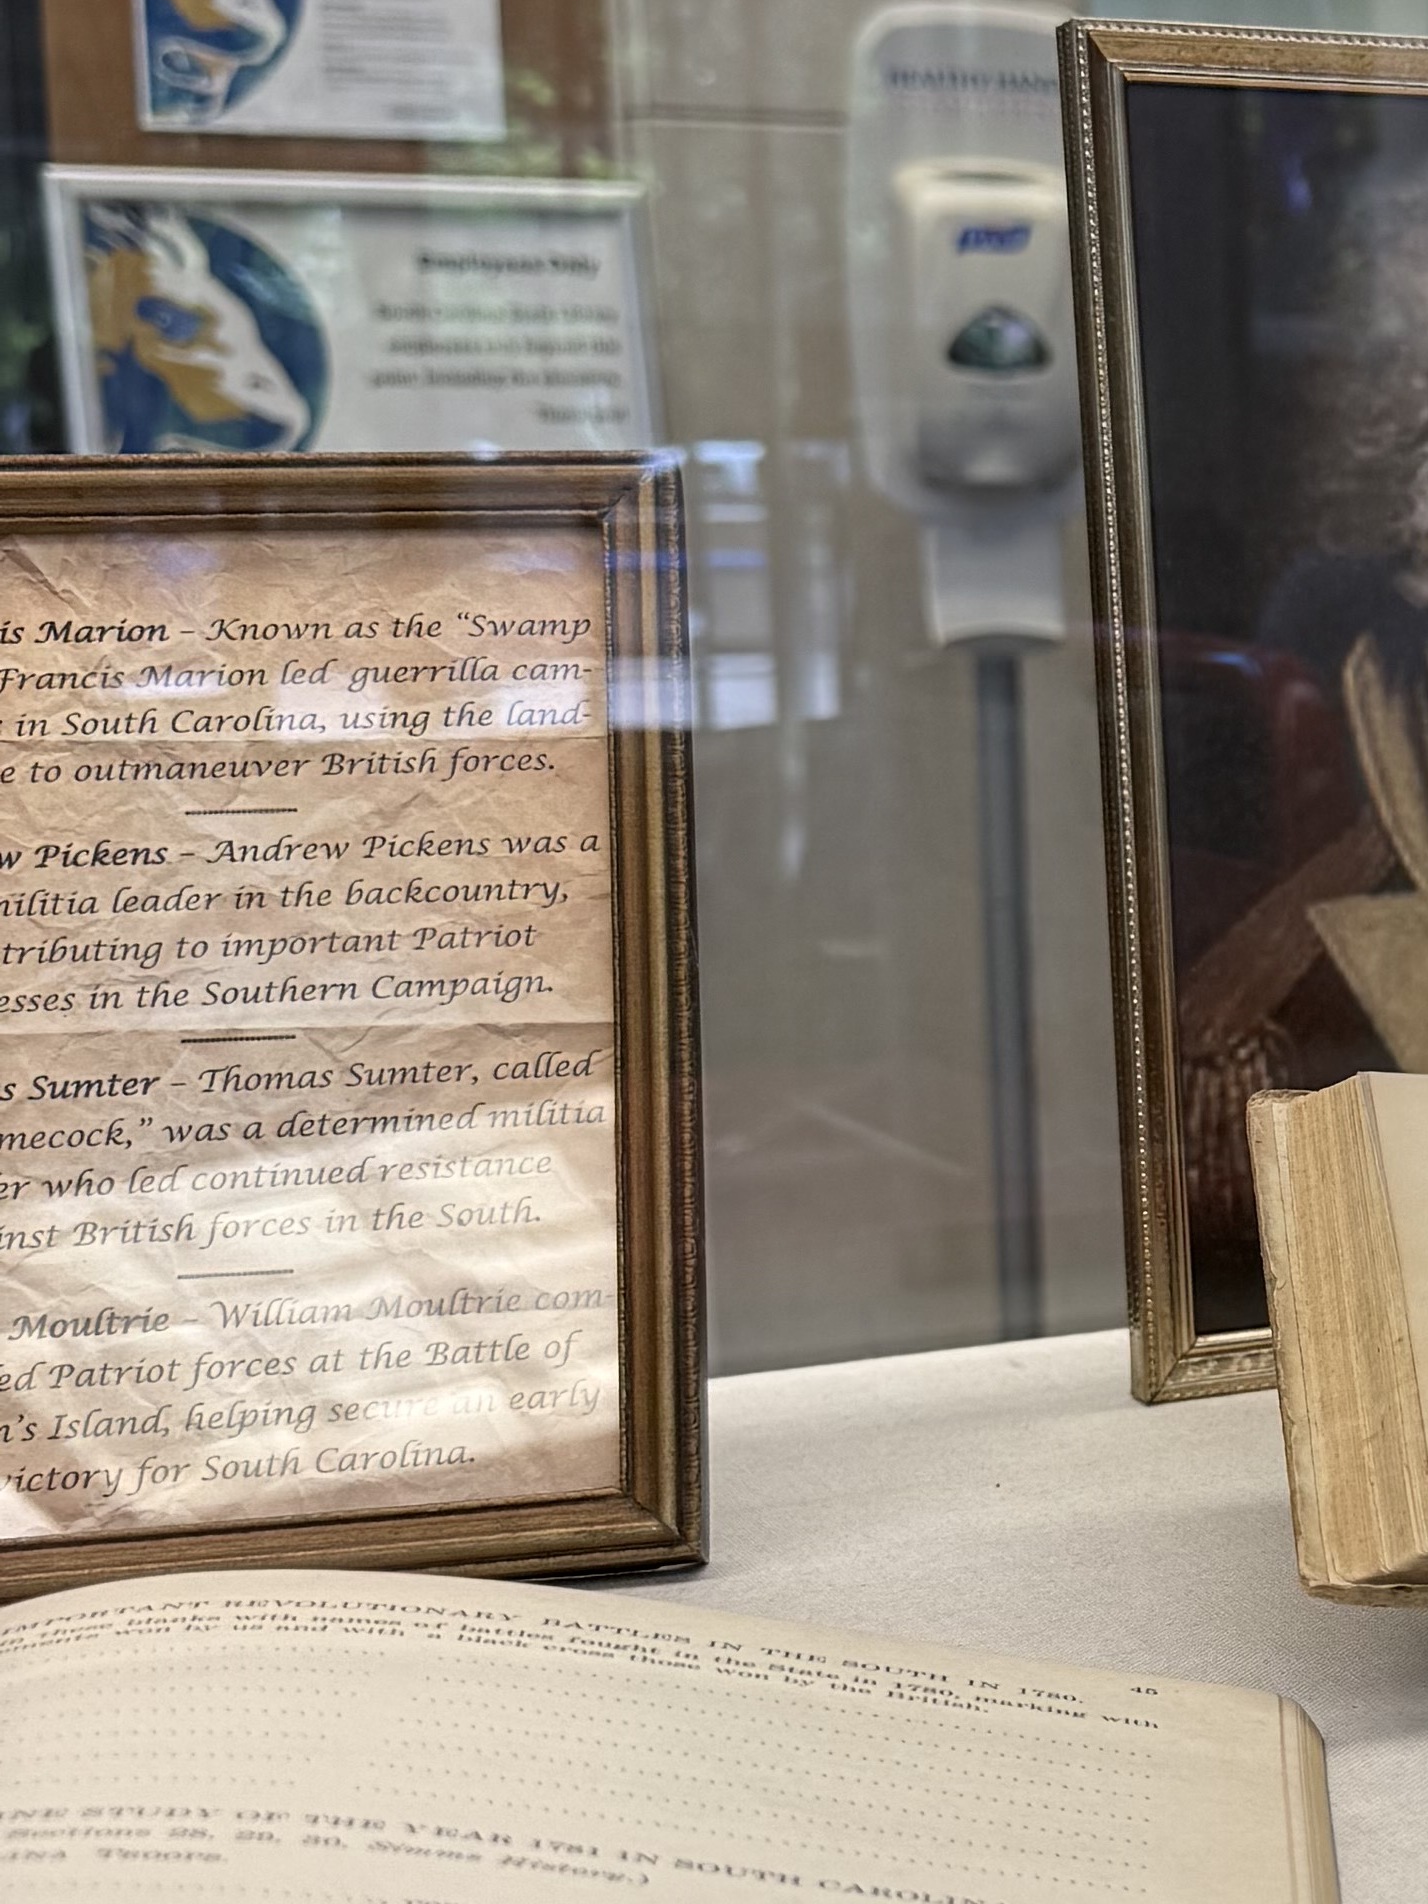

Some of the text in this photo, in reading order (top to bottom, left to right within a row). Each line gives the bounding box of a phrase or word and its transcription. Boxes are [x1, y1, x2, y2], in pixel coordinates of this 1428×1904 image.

[34, 618, 170, 643] Marion
[204, 618, 333, 641] Known
[343, 621, 379, 638] as
[389, 612, 442, 638] the
[0, 656, 592, 694] Francis Marion led guerrilla cam-
[15, 691, 600, 737] in South Carolina, using the land-
[30, 762, 61, 783] to
[74, 752, 311, 782] outmaneuver
[321, 747, 439, 776] British
[439, 746, 554, 782] forces.
[34, 839, 168, 868] Pickens
[198, 834, 350, 864] Andrew
[362, 830, 491, 859] Pickens
[500, 836, 568, 854] was
[580, 835, 600, 852] a
[112, 877, 573, 913] leader in the backcountry,
[176, 919, 537, 965] to important Patriot
[89, 970, 553, 1013] in the Southern Campaign.
[26, 1049, 602, 1100] Sumter Thomas Sumter, called
[161, 1099, 603, 1143] was a determined militia
[34, 1151, 551, 1198] who led continued resistance
[72, 1196, 540, 1250] British forces in the South.
[7, 1284, 613, 1341] Moultrie William Moultrie com-
[48, 1329, 583, 1392] Patriot forces at the Battle of
[46, 1378, 600, 1440] Island, helping secure an early
[127, 1440, 475, 1496] for South Carolina.
[224, 1596, 1159, 1705] REVOLUTIONARY BATTLES IN THE SOUTH IN 1780. 45
